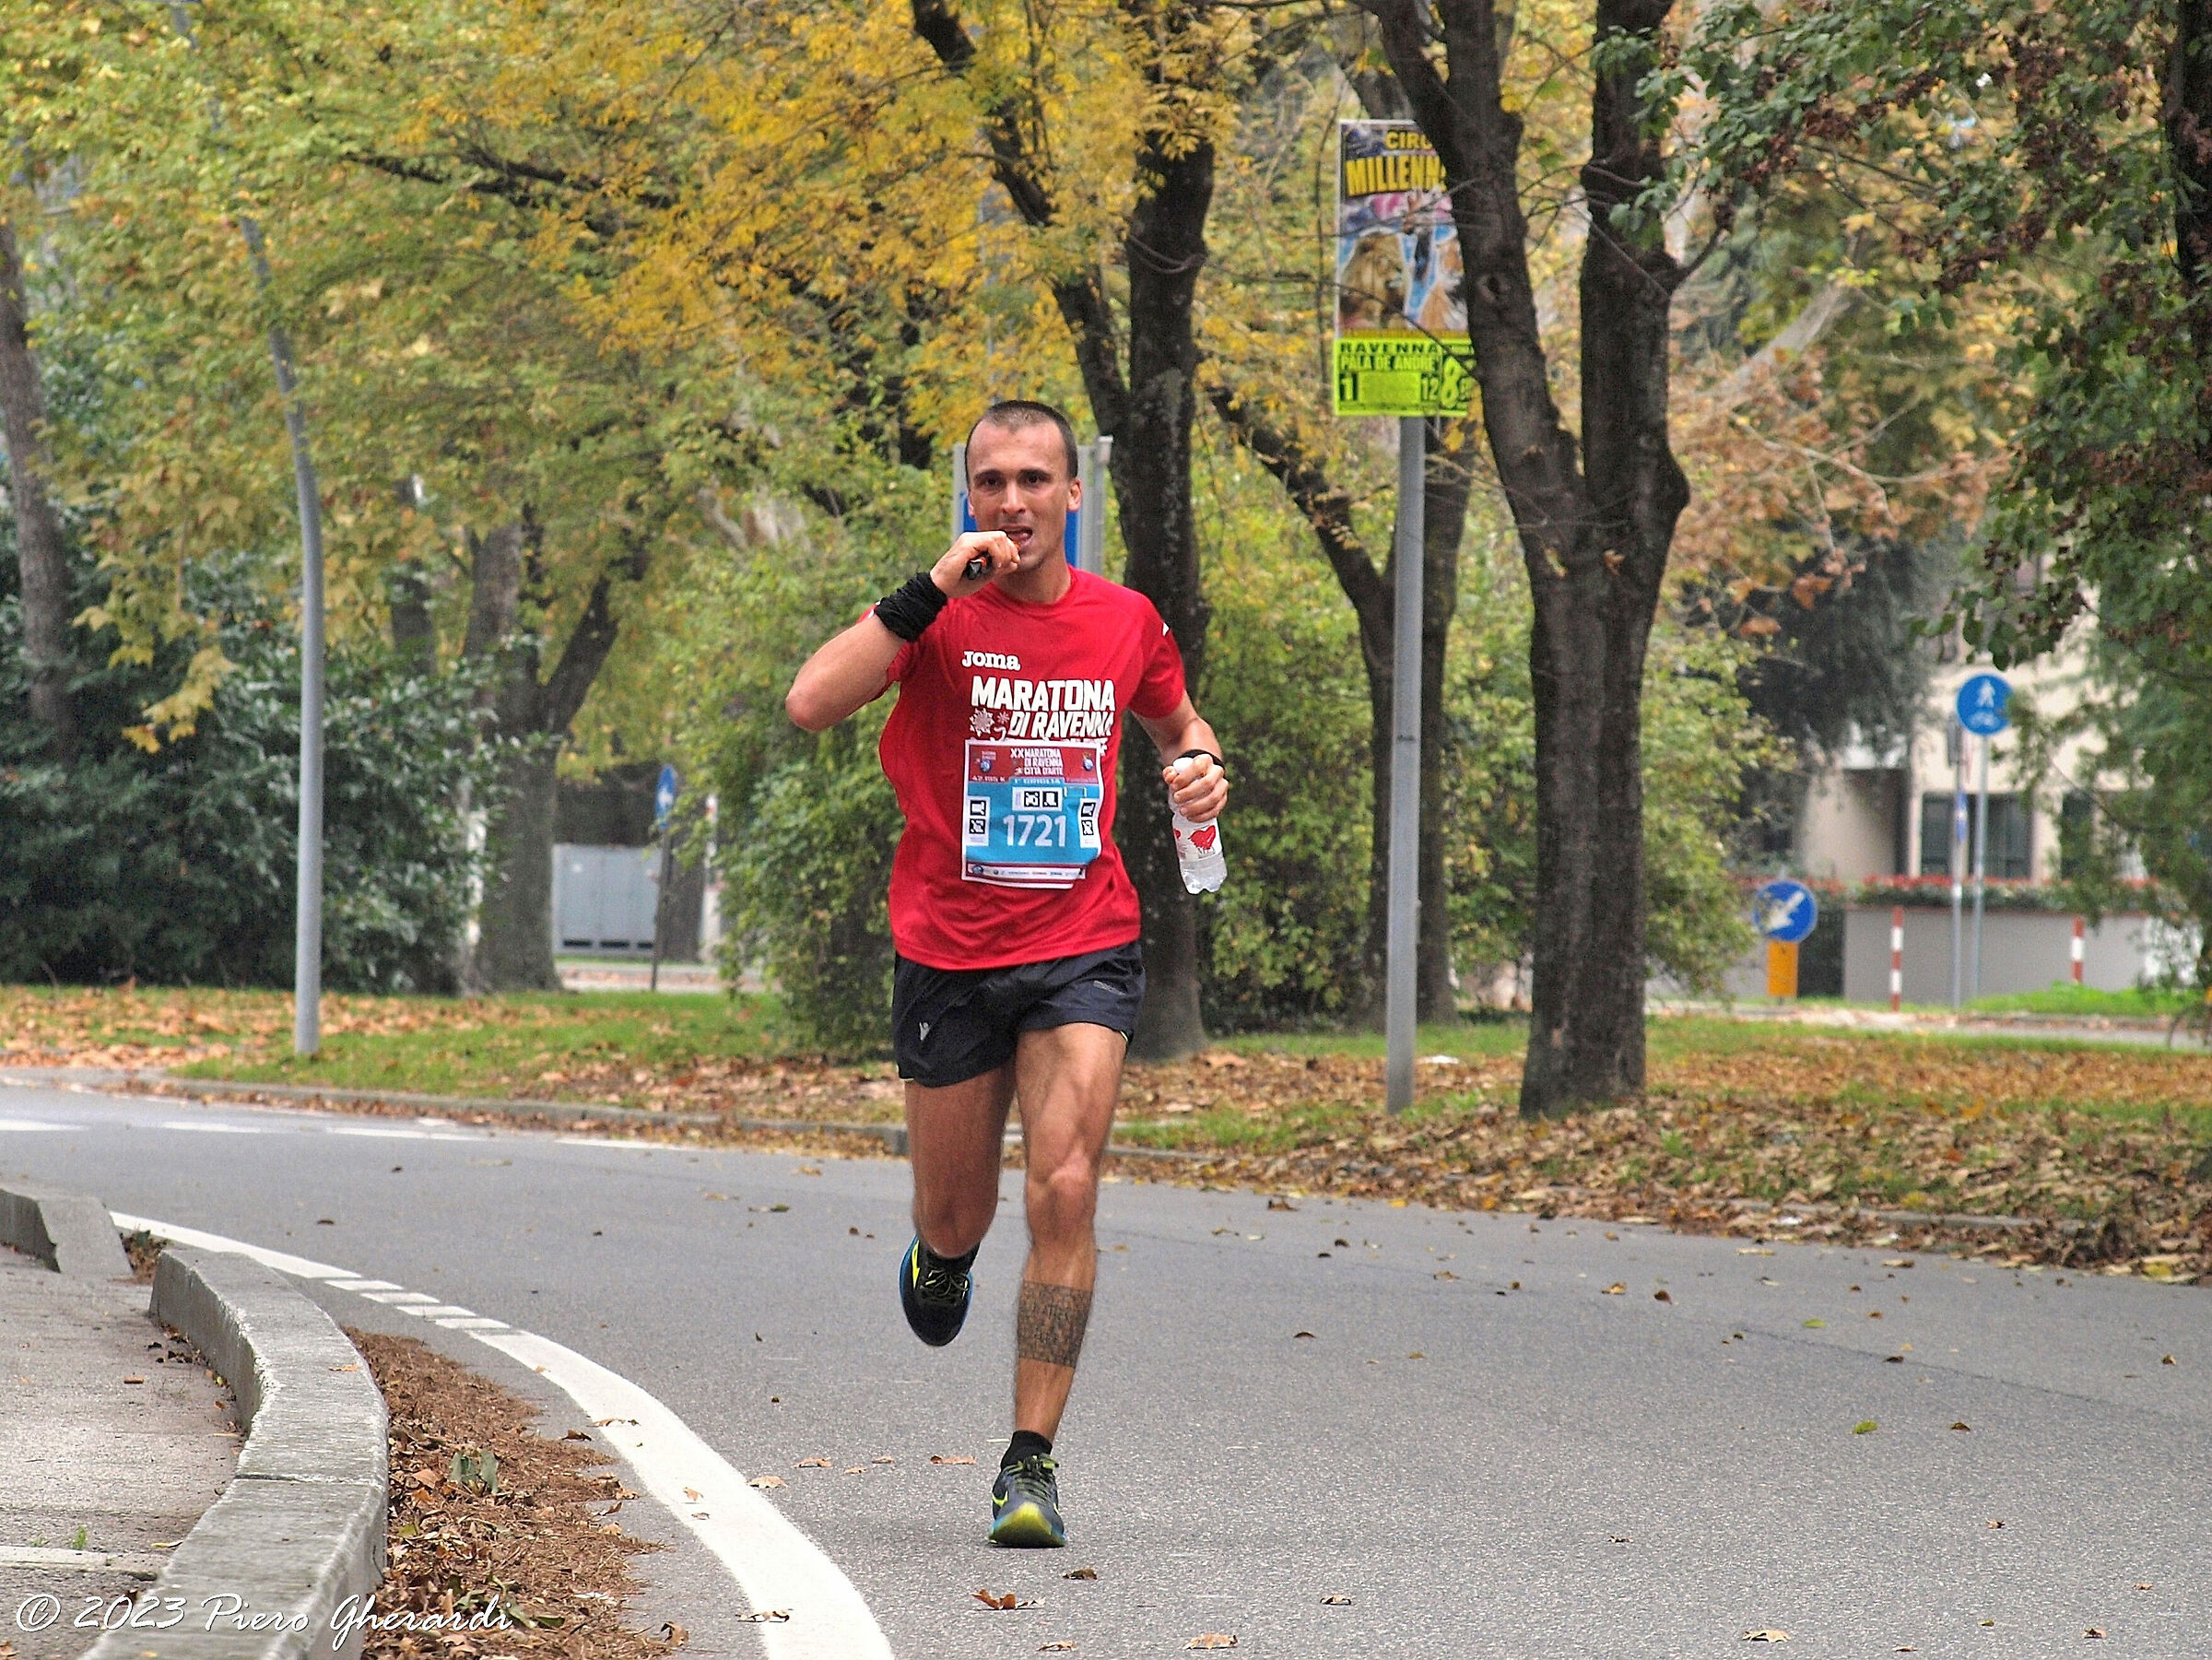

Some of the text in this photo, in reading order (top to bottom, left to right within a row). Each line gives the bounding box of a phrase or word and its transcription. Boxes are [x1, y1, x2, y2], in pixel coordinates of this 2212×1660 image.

[1340, 343, 1438, 353] RAVENNA
[971, 676, 1115, 712] MARATONA
[1009, 711, 1114, 738] DI RAVENNA
[1010, 748, 1062, 759] XX MARATONA
[1032, 758, 1063, 767] RAVENNA
[1003, 815, 1066, 847] 1721
